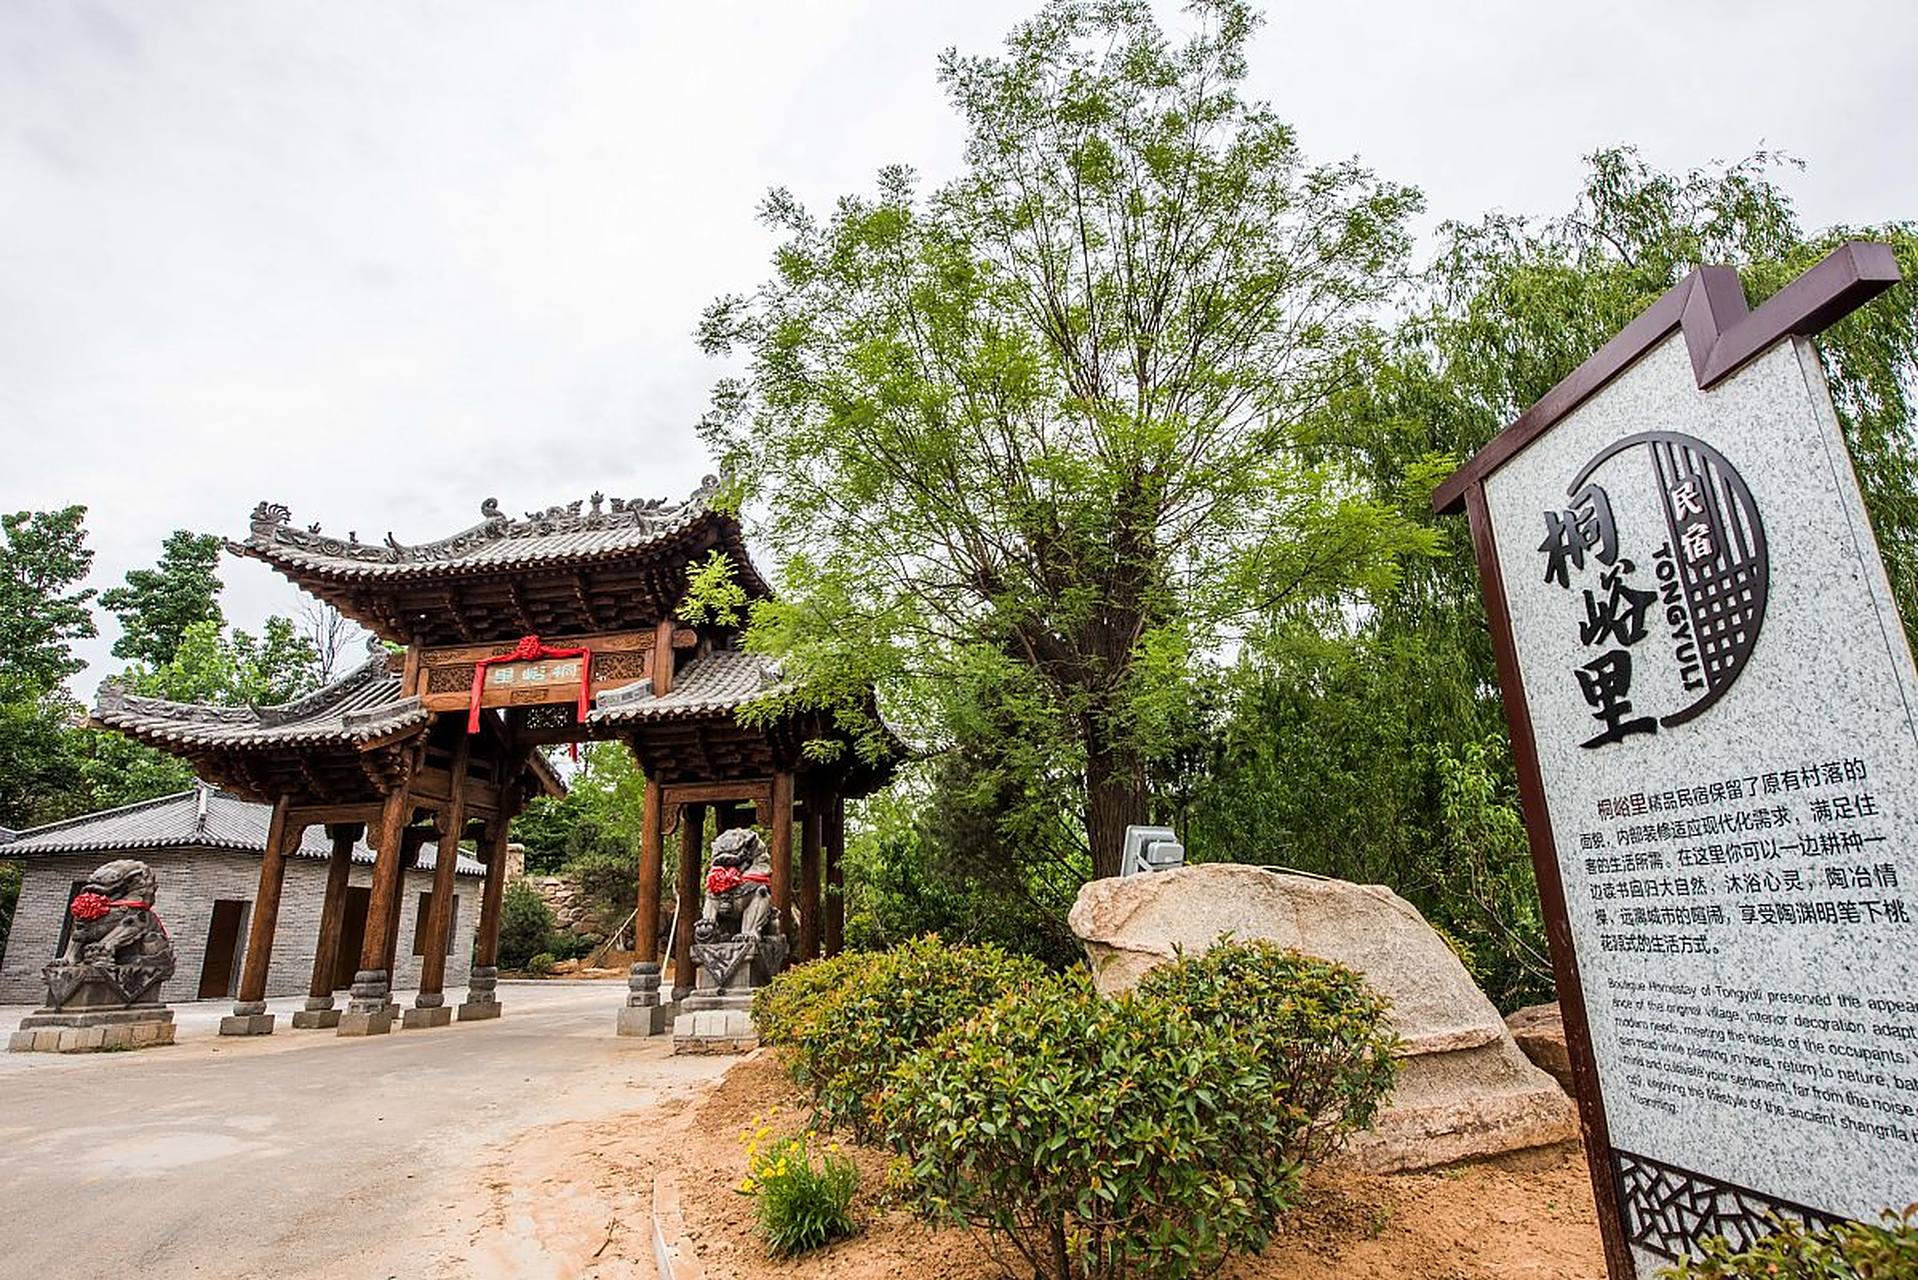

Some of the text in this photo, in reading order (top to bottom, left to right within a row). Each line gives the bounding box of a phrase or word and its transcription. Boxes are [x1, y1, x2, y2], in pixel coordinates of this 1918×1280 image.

[1671, 481, 1714, 564] 民宿
[1538, 483, 1658, 749] 桐峪里
[1652, 541, 1705, 692] TONGYULI
[1597, 757, 1868, 821] 桐峪里精品民宿保留了原有村落的
[1701, 984, 1711, 996] of
[1767, 992, 1832, 1006] preserved
[1838, 993, 1861, 1008] the
[1746, 1010, 1787, 1025] interior
[1794, 1014, 1866, 1034] decoration
[1684, 1026, 1725, 1042] meeting
[1727, 1029, 1745, 1043] the
[1748, 1034, 1785, 1048] needs
[1788, 1037, 1800, 1049] of
[1803, 1039, 1825, 1054] the
[1828, 1044, 1909, 1064] occupants.
[1706, 1070, 1728, 1082] your
[1793, 1082, 1809, 1097] far
[1812, 1086, 1844, 1103] from
[1846, 1091, 1870, 1108] the
[1872, 1099, 1915, 1116] noise
[1778, 1059, 1816, 1078] return
[1820, 1064, 1834, 1078] to
[1838, 1069, 1890, 1089] nature,
[1750, 1099, 1762, 1110] of
[1764, 1100, 1785, 1116] the
[1789, 1107, 1837, 1127] ancient
[1841, 1116, 1908, 1141] shangrila
